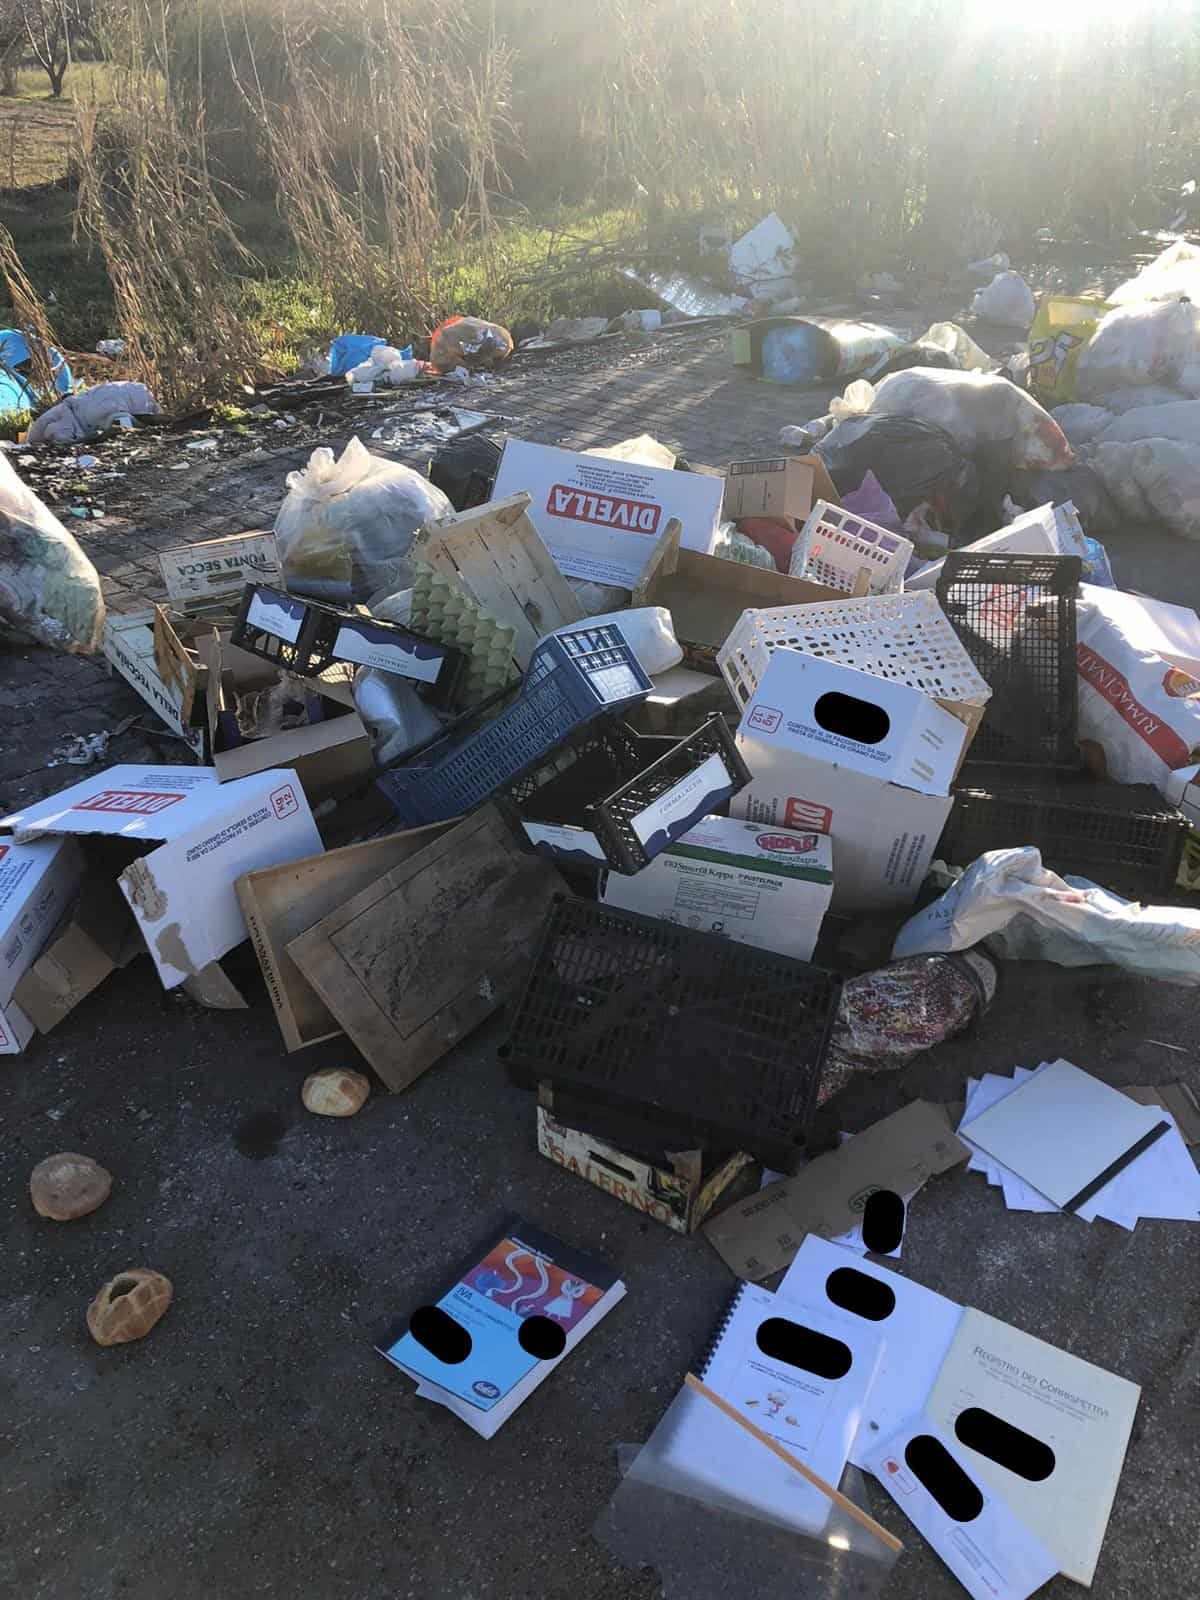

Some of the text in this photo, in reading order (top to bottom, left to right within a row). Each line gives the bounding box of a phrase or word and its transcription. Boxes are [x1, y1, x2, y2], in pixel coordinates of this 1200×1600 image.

[555, 488, 657, 531] DIVELLA
[178, 560, 221, 576] SECCA
[153, 690, 179, 721] DELLA
[751, 712, 763, 724] 12
[283, 791, 294, 806] 12
[227, 818, 247, 833] SEMOLA
[202, 833, 221, 848] GRANO
[186, 844, 203, 857] DURO
[455, 1286, 474, 1301] IVA
